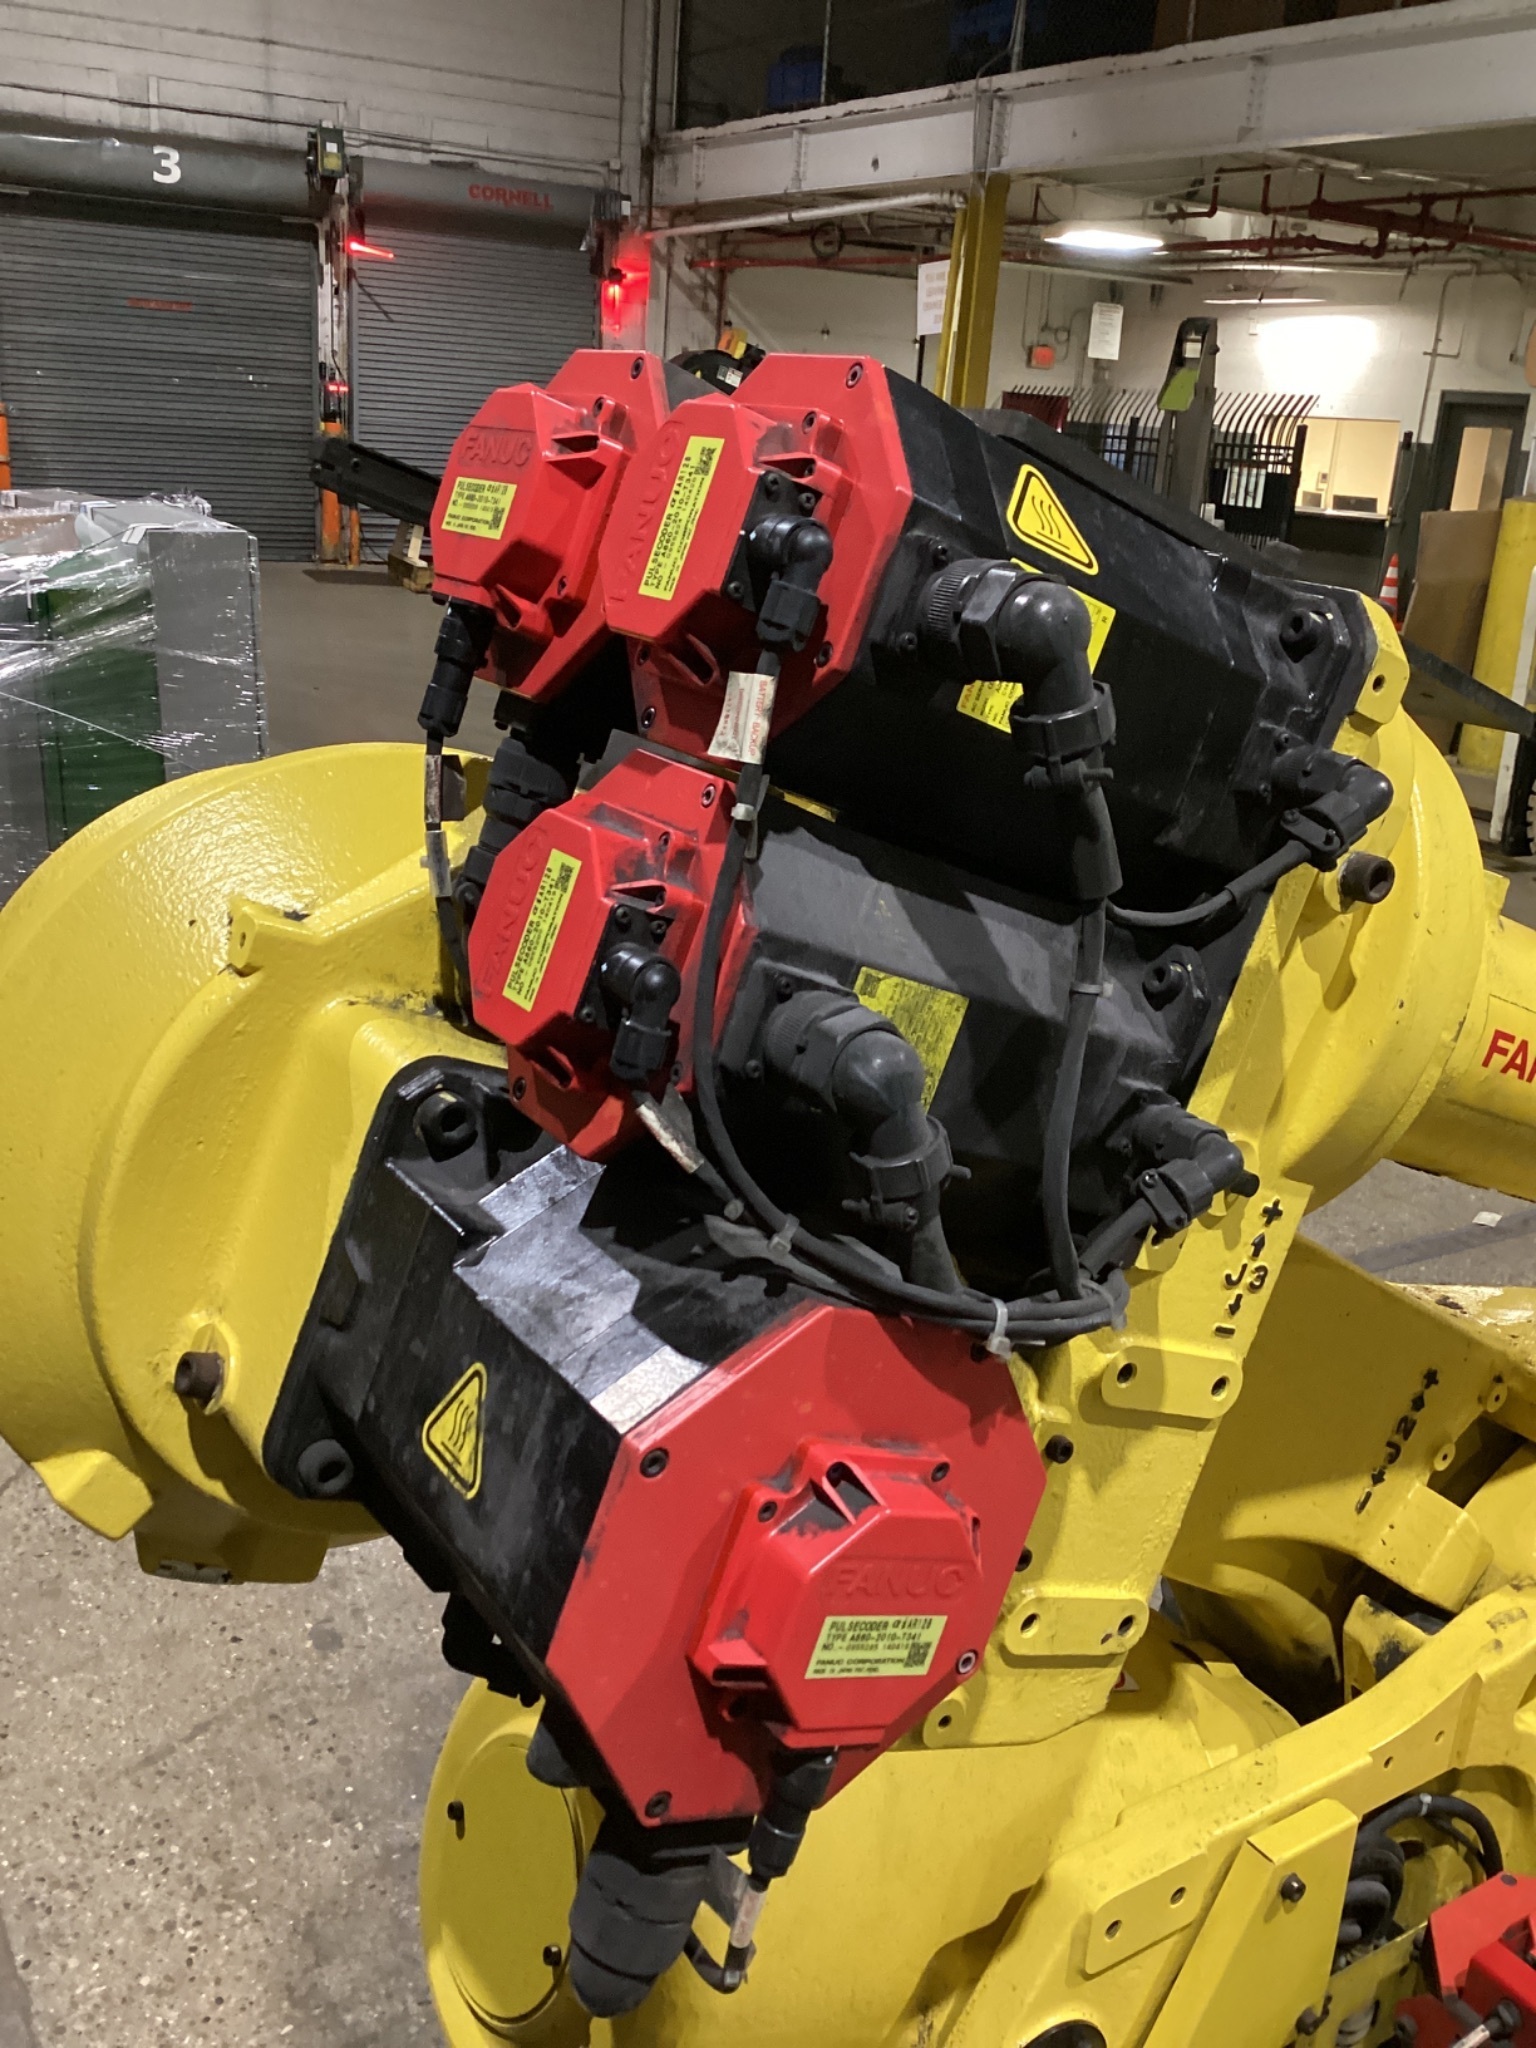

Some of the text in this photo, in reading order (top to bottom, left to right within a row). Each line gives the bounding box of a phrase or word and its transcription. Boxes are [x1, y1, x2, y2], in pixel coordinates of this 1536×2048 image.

[152, 148, 182, 184] 3
[468, 183, 553, 212] CORNELL
[459, 432, 532, 467] FANUC
[643, 513, 673, 586] PULSECODER
[650, 561, 663, 587] TYPE
[748, 680, 768, 756] BATTERY BACKUP
[506, 919, 535, 990] PULSECODER
[512, 967, 524, 992] TYPE
[1224, 1262, 1269, 1291] J3
[1385, 1414, 1417, 1465] J2
[824, 1633, 847, 1641] TYPE
[828, 1620, 889, 1630] PULSECODER
